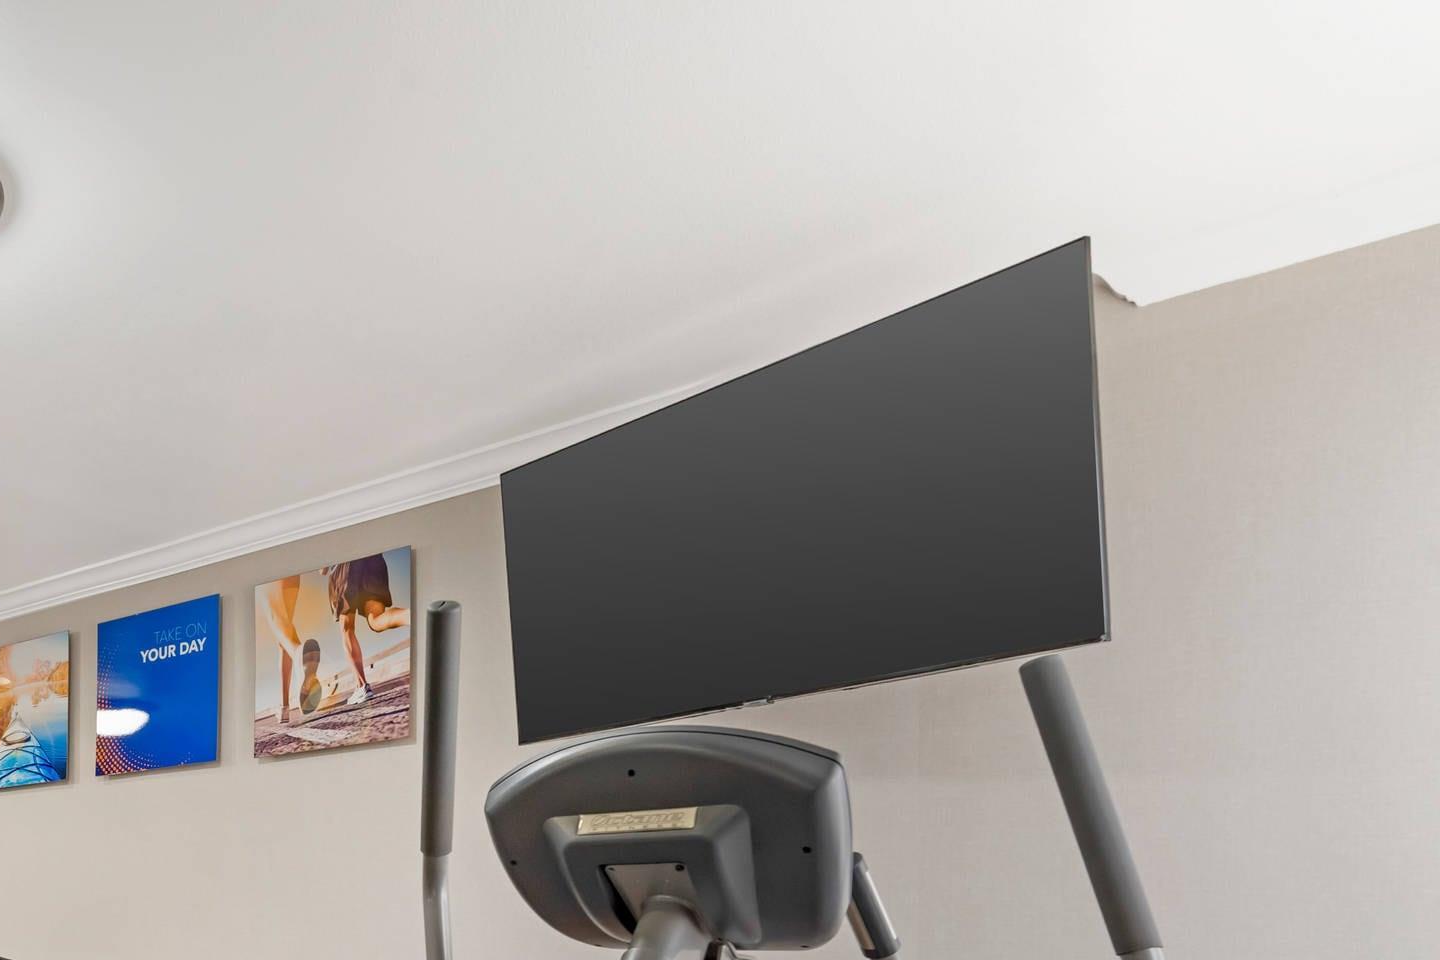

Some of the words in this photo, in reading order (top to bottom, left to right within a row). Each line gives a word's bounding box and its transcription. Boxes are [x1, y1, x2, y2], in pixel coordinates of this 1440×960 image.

[154, 626, 182, 643] TAKE
[185, 622, 207, 638] ON
[140, 644, 176, 663] YOUR
[179, 637, 207, 655] DAY
